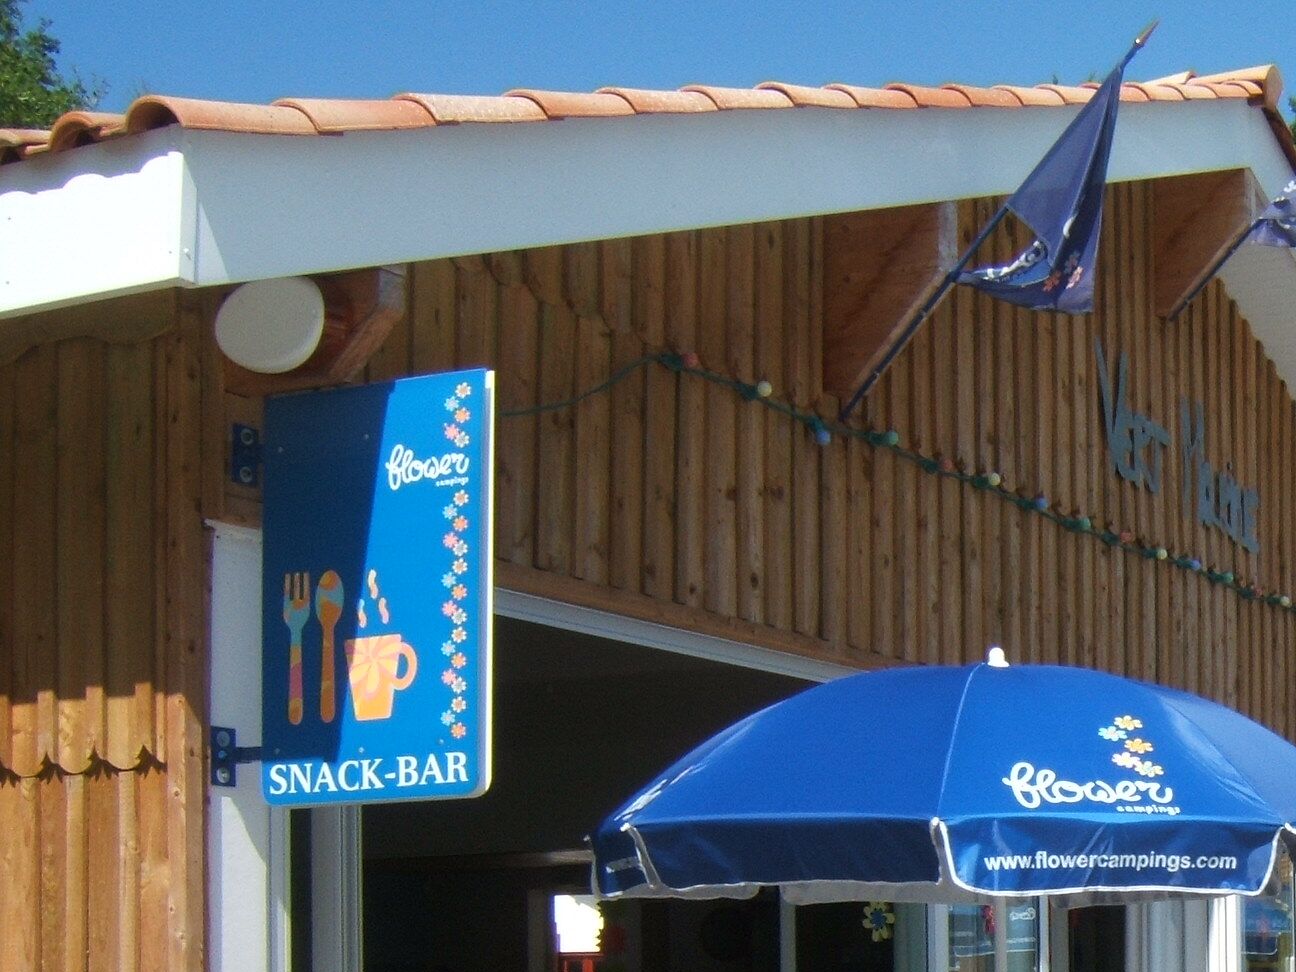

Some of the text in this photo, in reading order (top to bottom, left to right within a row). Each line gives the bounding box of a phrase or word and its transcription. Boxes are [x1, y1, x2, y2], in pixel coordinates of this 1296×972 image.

[385, 444, 470, 491] flower
[268, 751, 469, 796] SNACK-BAR
[1002, 762, 1173, 809] flower
[1116, 804, 1181, 816] campings
[984, 850, 1238, 872] www.flowercampings.com
